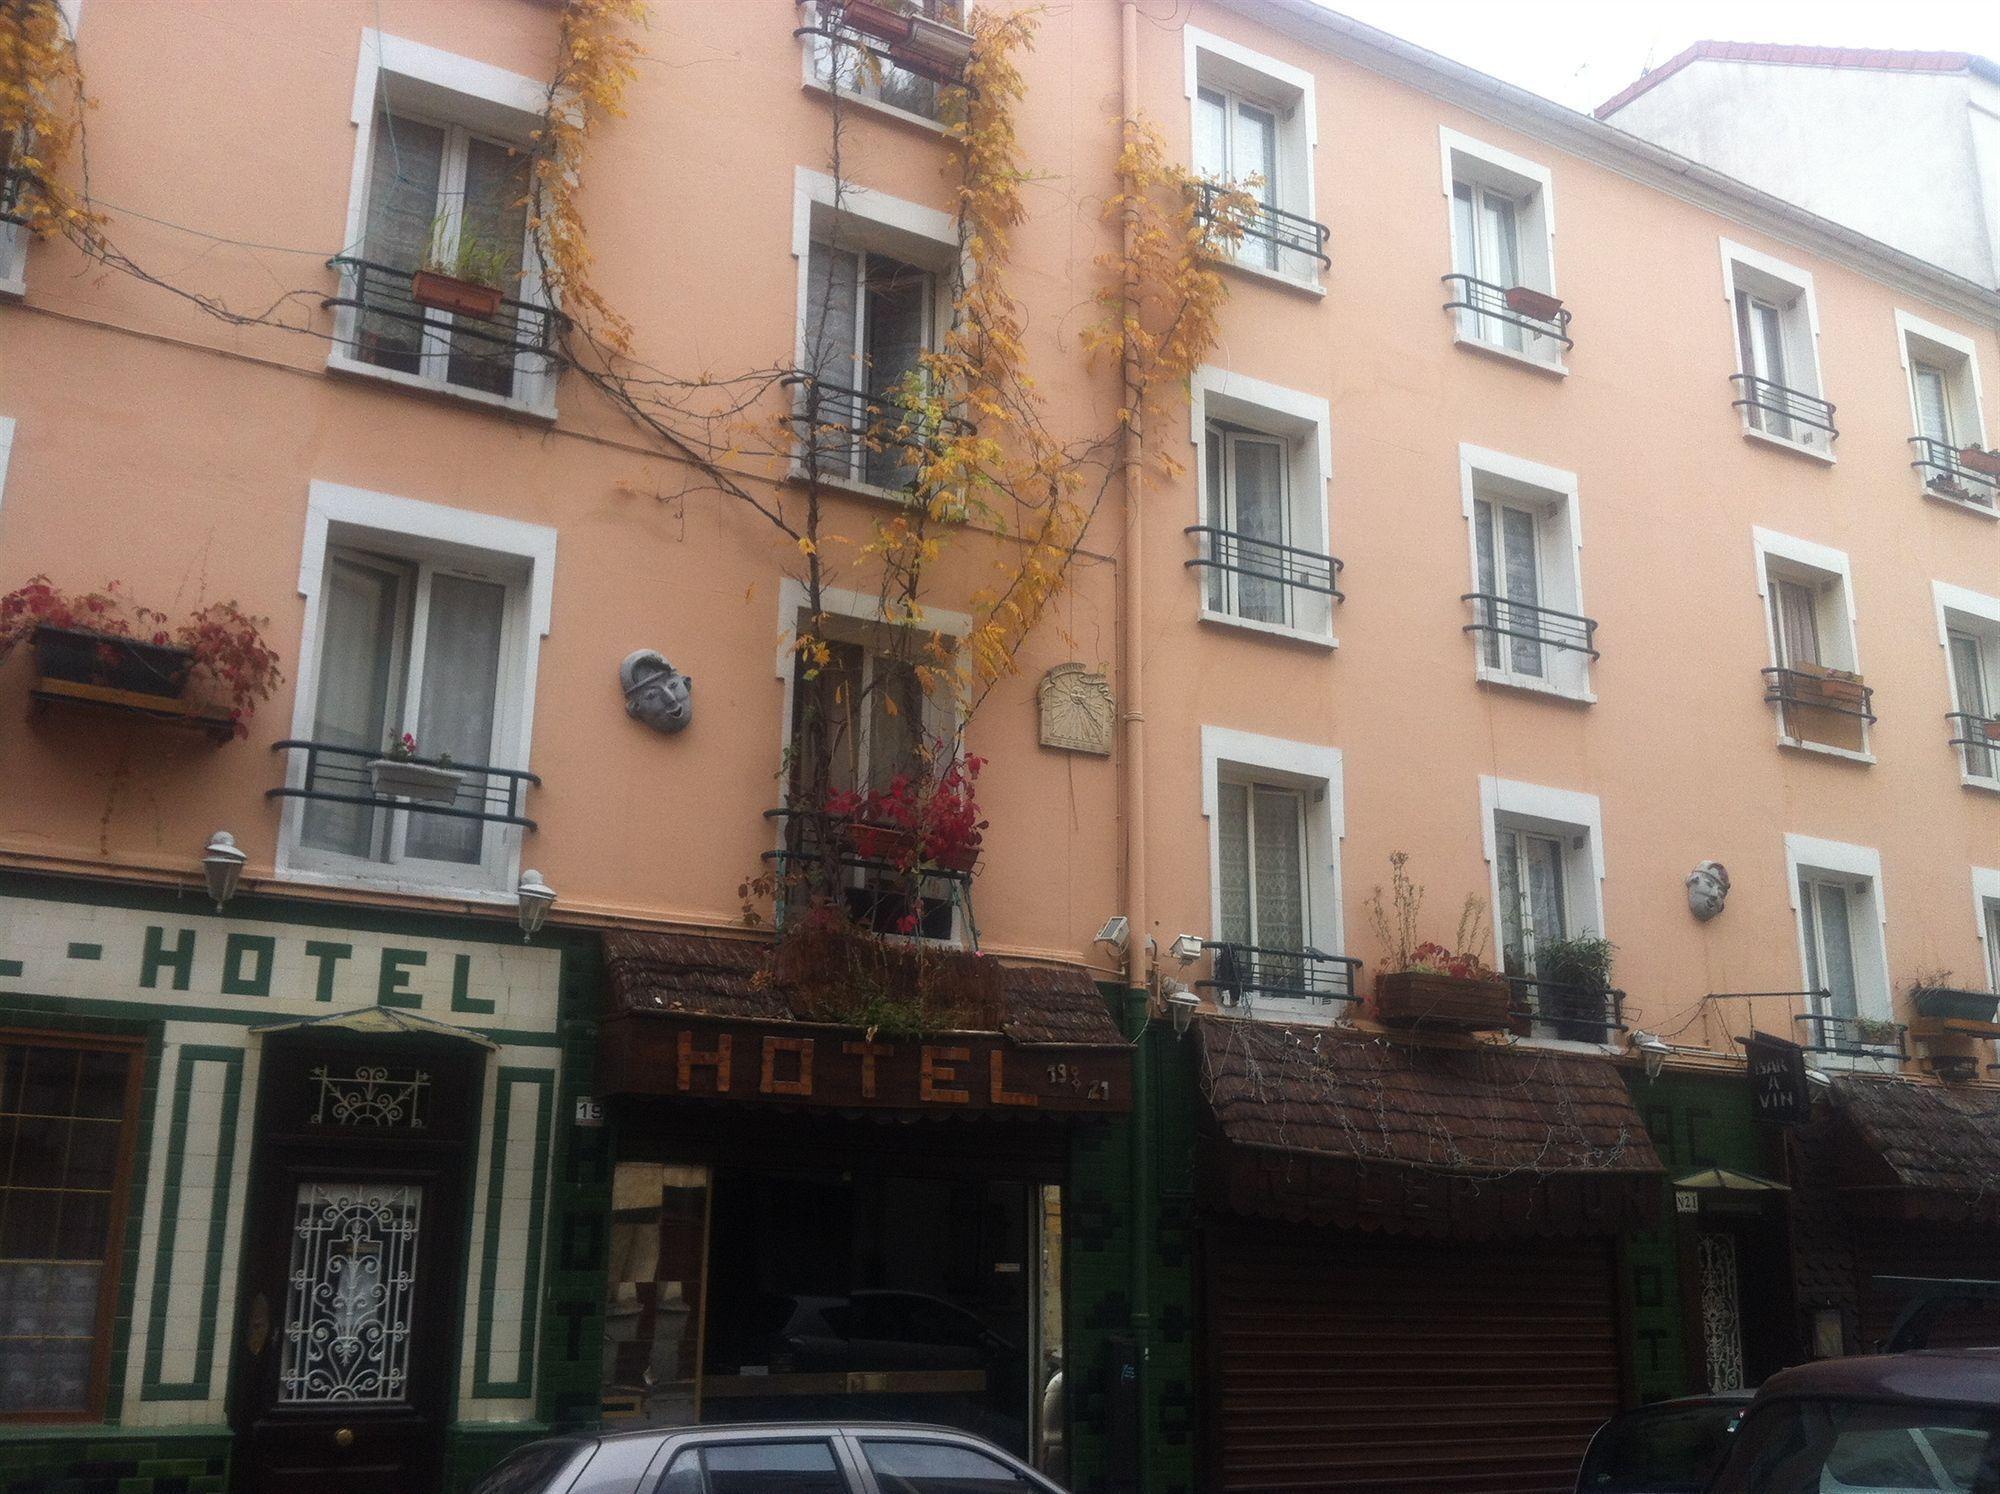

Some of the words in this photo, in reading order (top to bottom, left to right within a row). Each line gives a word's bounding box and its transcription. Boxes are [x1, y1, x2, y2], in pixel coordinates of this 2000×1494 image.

[140, 926, 496, 1014] HOTEL
[677, 1030, 1038, 1107] HOTEL
[1759, 1091, 1793, 1108] VIN
